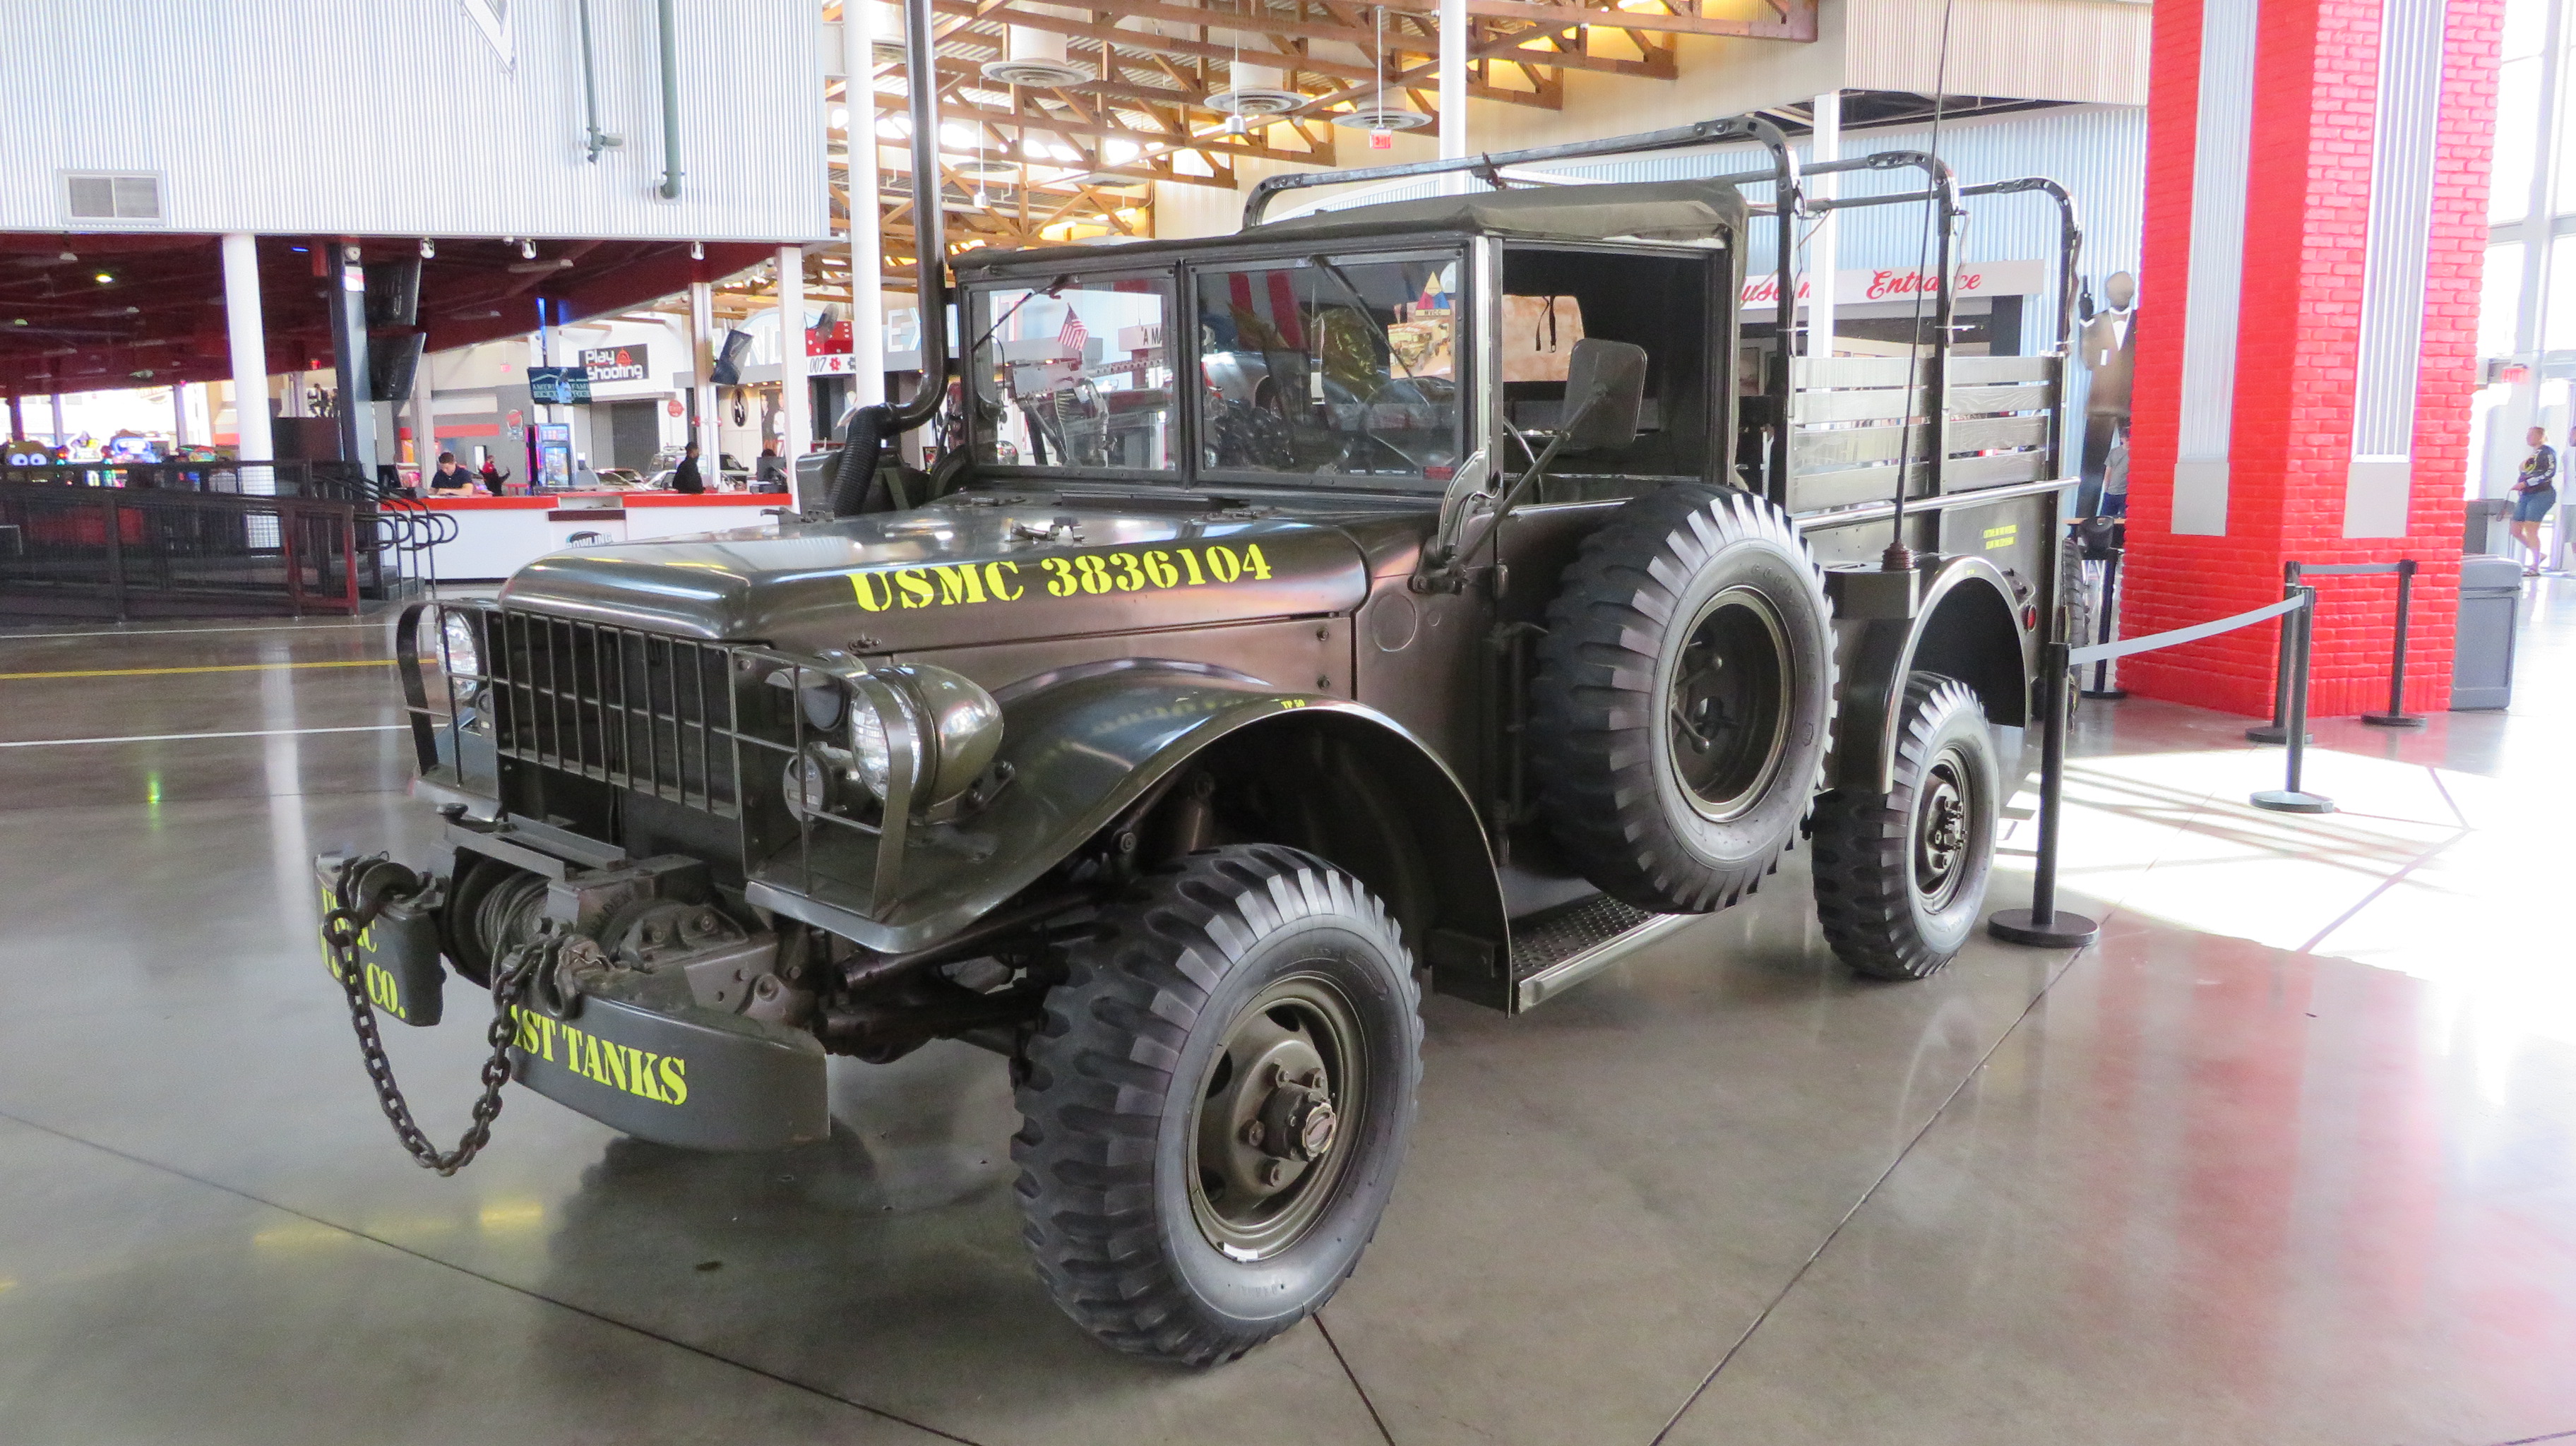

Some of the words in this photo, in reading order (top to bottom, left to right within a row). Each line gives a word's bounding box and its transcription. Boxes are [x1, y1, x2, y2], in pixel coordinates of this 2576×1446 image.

[1866, 270, 1981, 300] Entrace
[585, 349, 615, 364] Play
[587, 364, 643, 379] Shooting
[809, 357, 827, 373] 007
[847, 561, 1024, 611] USMC
[1041, 544, 1272, 597] 3836104
[366, 962, 406, 1019] CO.
[561, 1024, 688, 1106] TANKS
